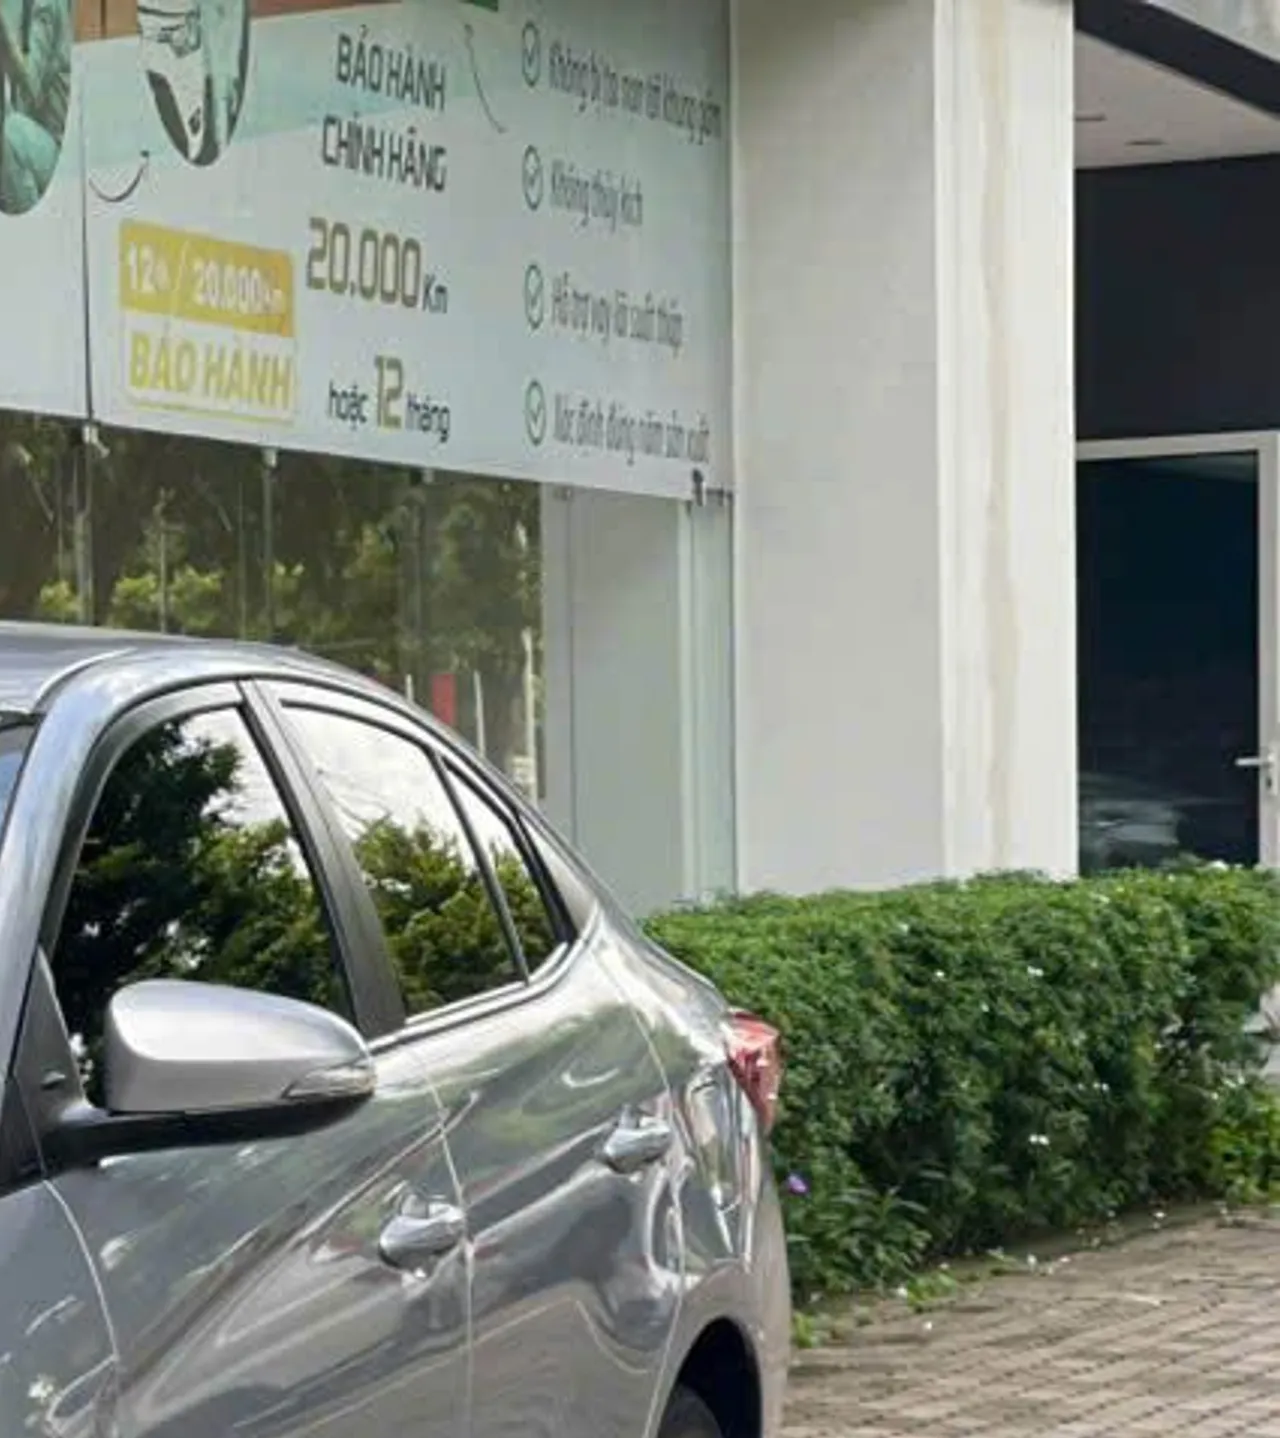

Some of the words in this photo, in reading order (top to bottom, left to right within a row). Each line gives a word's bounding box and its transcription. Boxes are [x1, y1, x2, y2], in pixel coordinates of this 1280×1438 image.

[336, 22, 383, 95] BẢO
[389, 46, 447, 113] HÀNH
[322, 111, 384, 181] CHÍNH
[373, 355, 404, 430] 12
